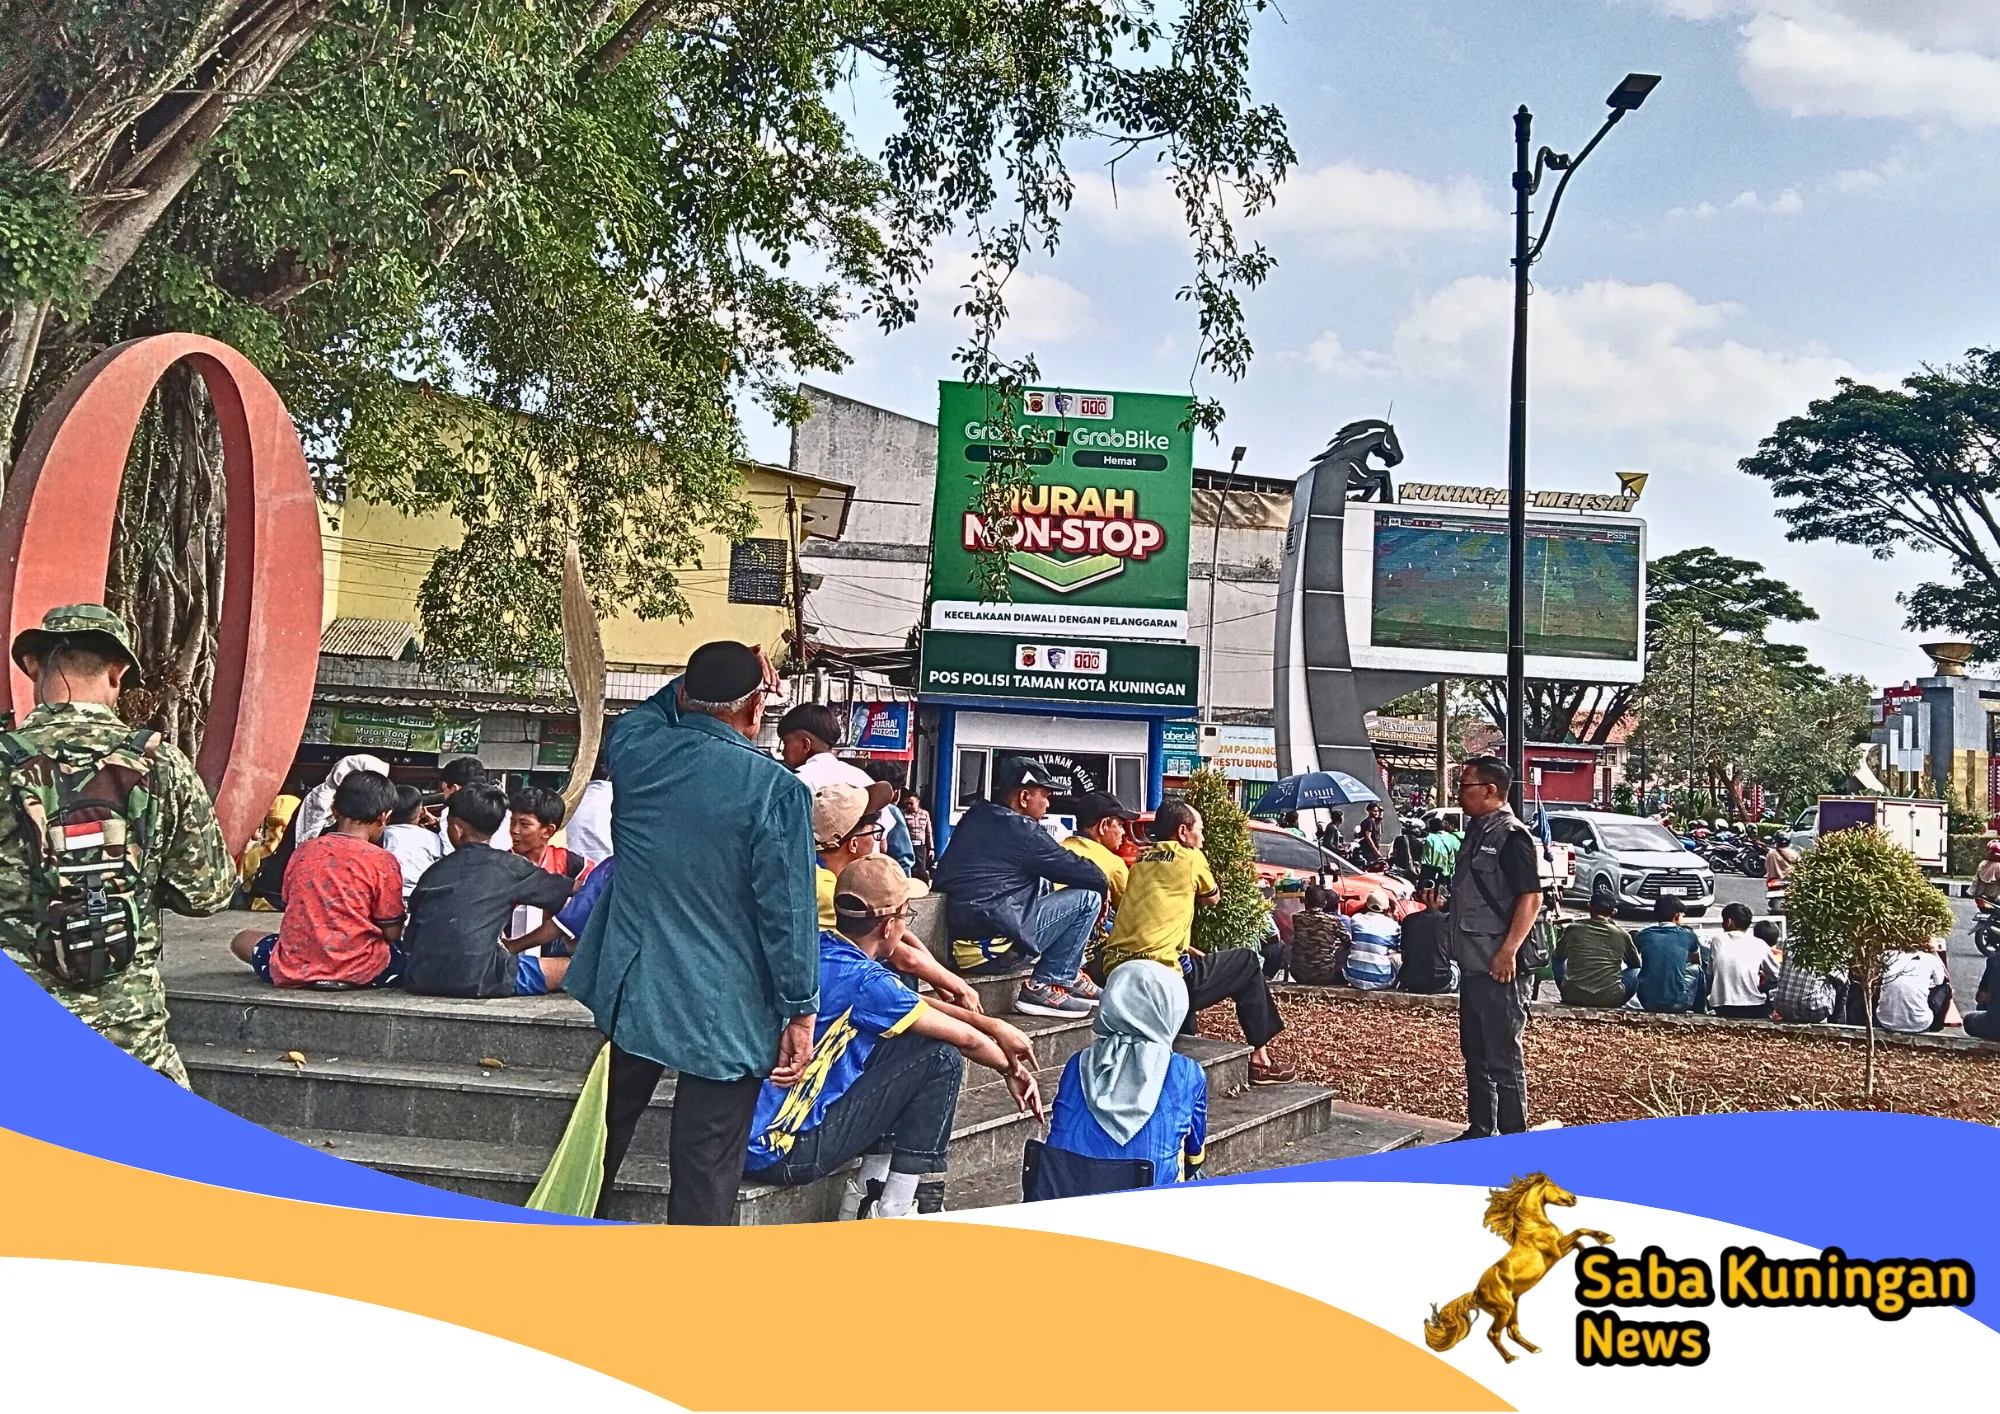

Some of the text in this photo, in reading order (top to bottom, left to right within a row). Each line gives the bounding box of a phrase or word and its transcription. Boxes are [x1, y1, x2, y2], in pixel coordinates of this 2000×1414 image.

[1082, 401, 1106, 414] 110
[1073, 427, 1169, 450] GrabBike
[1103, 455, 1137, 466] Hemat
[1534, 491, 1640, 512] MELESAT
[944, 610, 1178, 628] KECELAKAAN DIAWALI DENGAN PELANGGARAN
[1075, 654, 1099, 668] 110
[929, 670, 1186, 696] POS POLISI TAMAN KOTA KUNINGAN
[871, 711, 888, 721] JADI
[871, 719, 898, 728] JUARA!
[872, 728, 898, 737] mizone
[1213, 758, 1243, 767] RESTU
[1034, 754, 1095, 792] AYANAN POLISI
